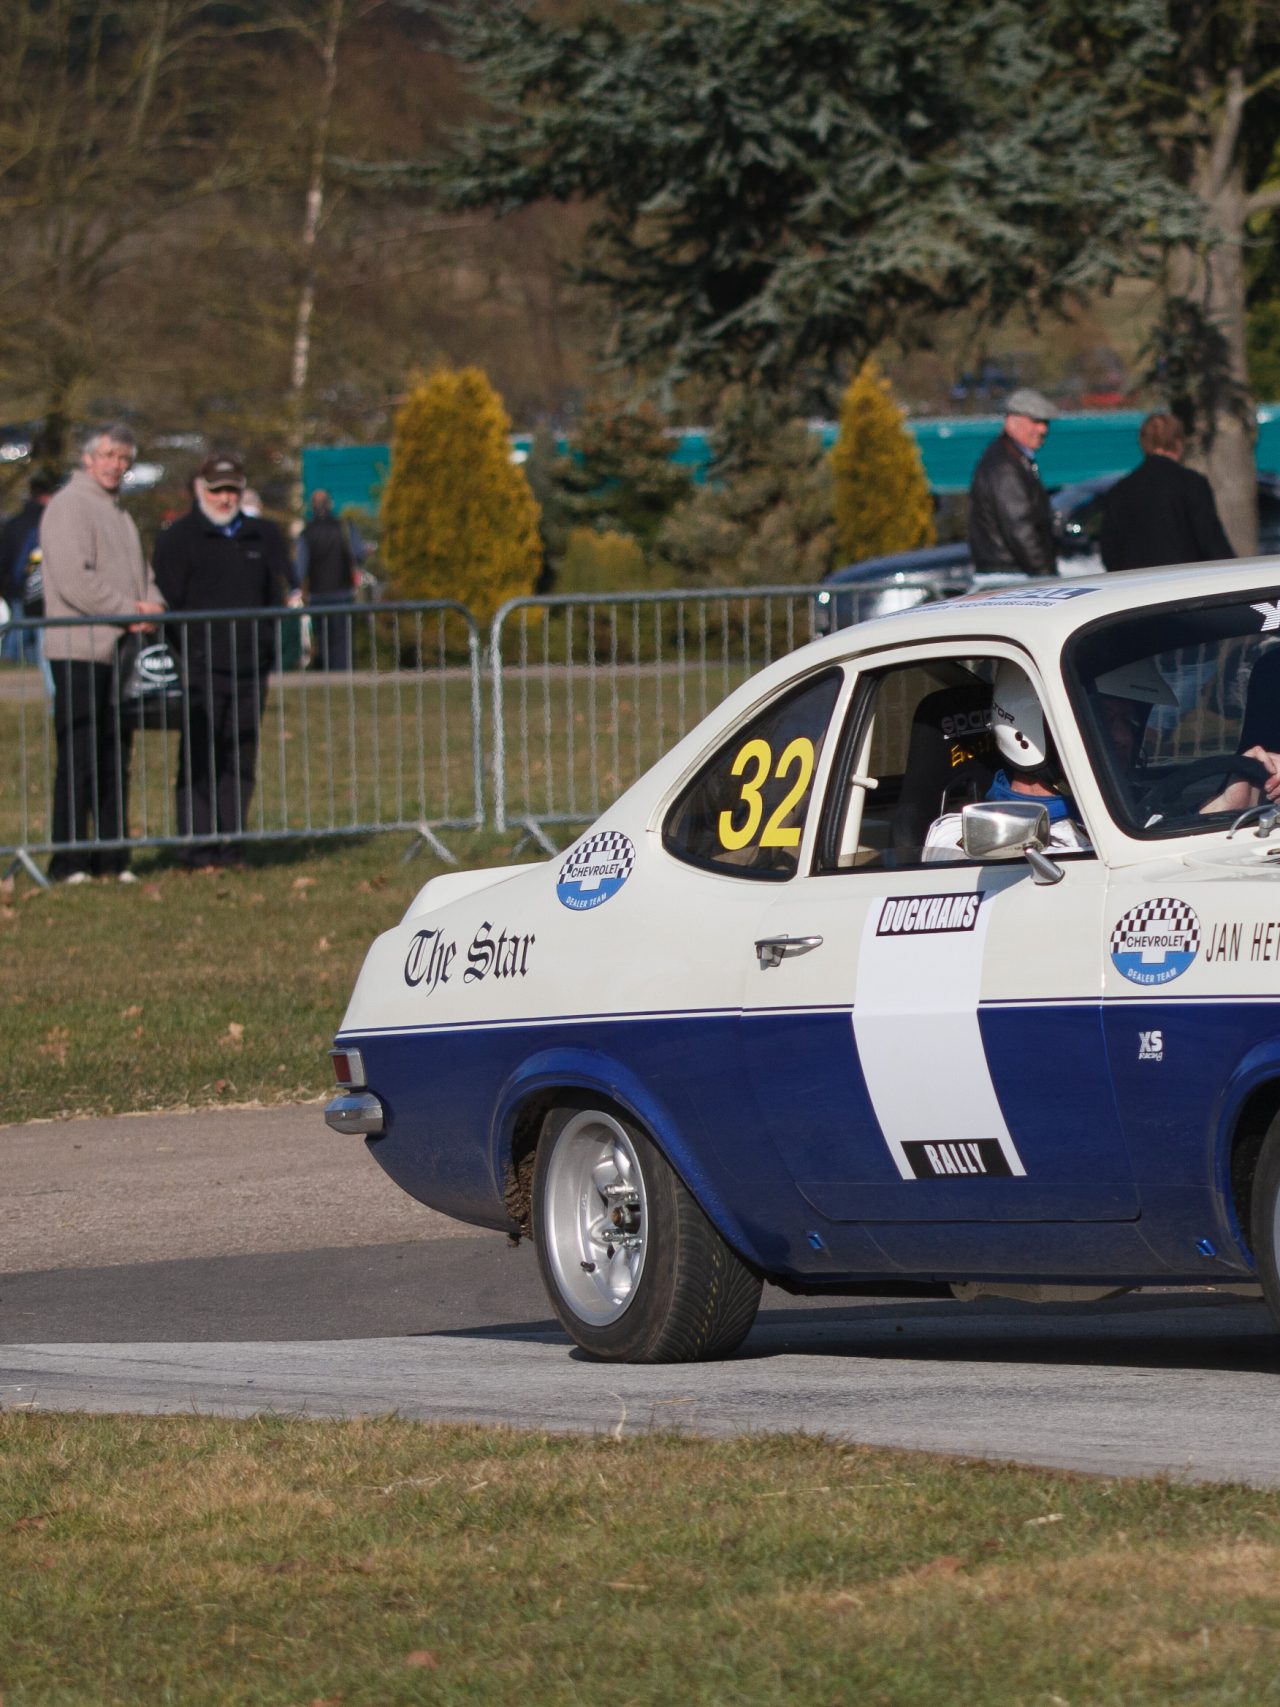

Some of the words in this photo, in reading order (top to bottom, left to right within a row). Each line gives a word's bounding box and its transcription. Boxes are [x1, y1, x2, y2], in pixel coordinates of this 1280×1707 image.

[719, 737, 815, 850] 32
[571, 863, 620, 878] CHEVROLET
[566, 895, 588, 908] DEALER
[589, 892, 607, 907] TEAM
[879, 895, 980, 933] DUCKHAMS
[1126, 935, 1186, 948] CHEVROLET
[1205, 923, 1243, 962] JAN
[404, 926, 457, 997] The
[463, 921, 536, 984] Star
[1127, 968, 1155, 982] DEALER
[1156, 967, 1177, 981] TEAM
[1138, 1030, 1163, 1053] XS
[923, 1142, 988, 1175] RALLY
